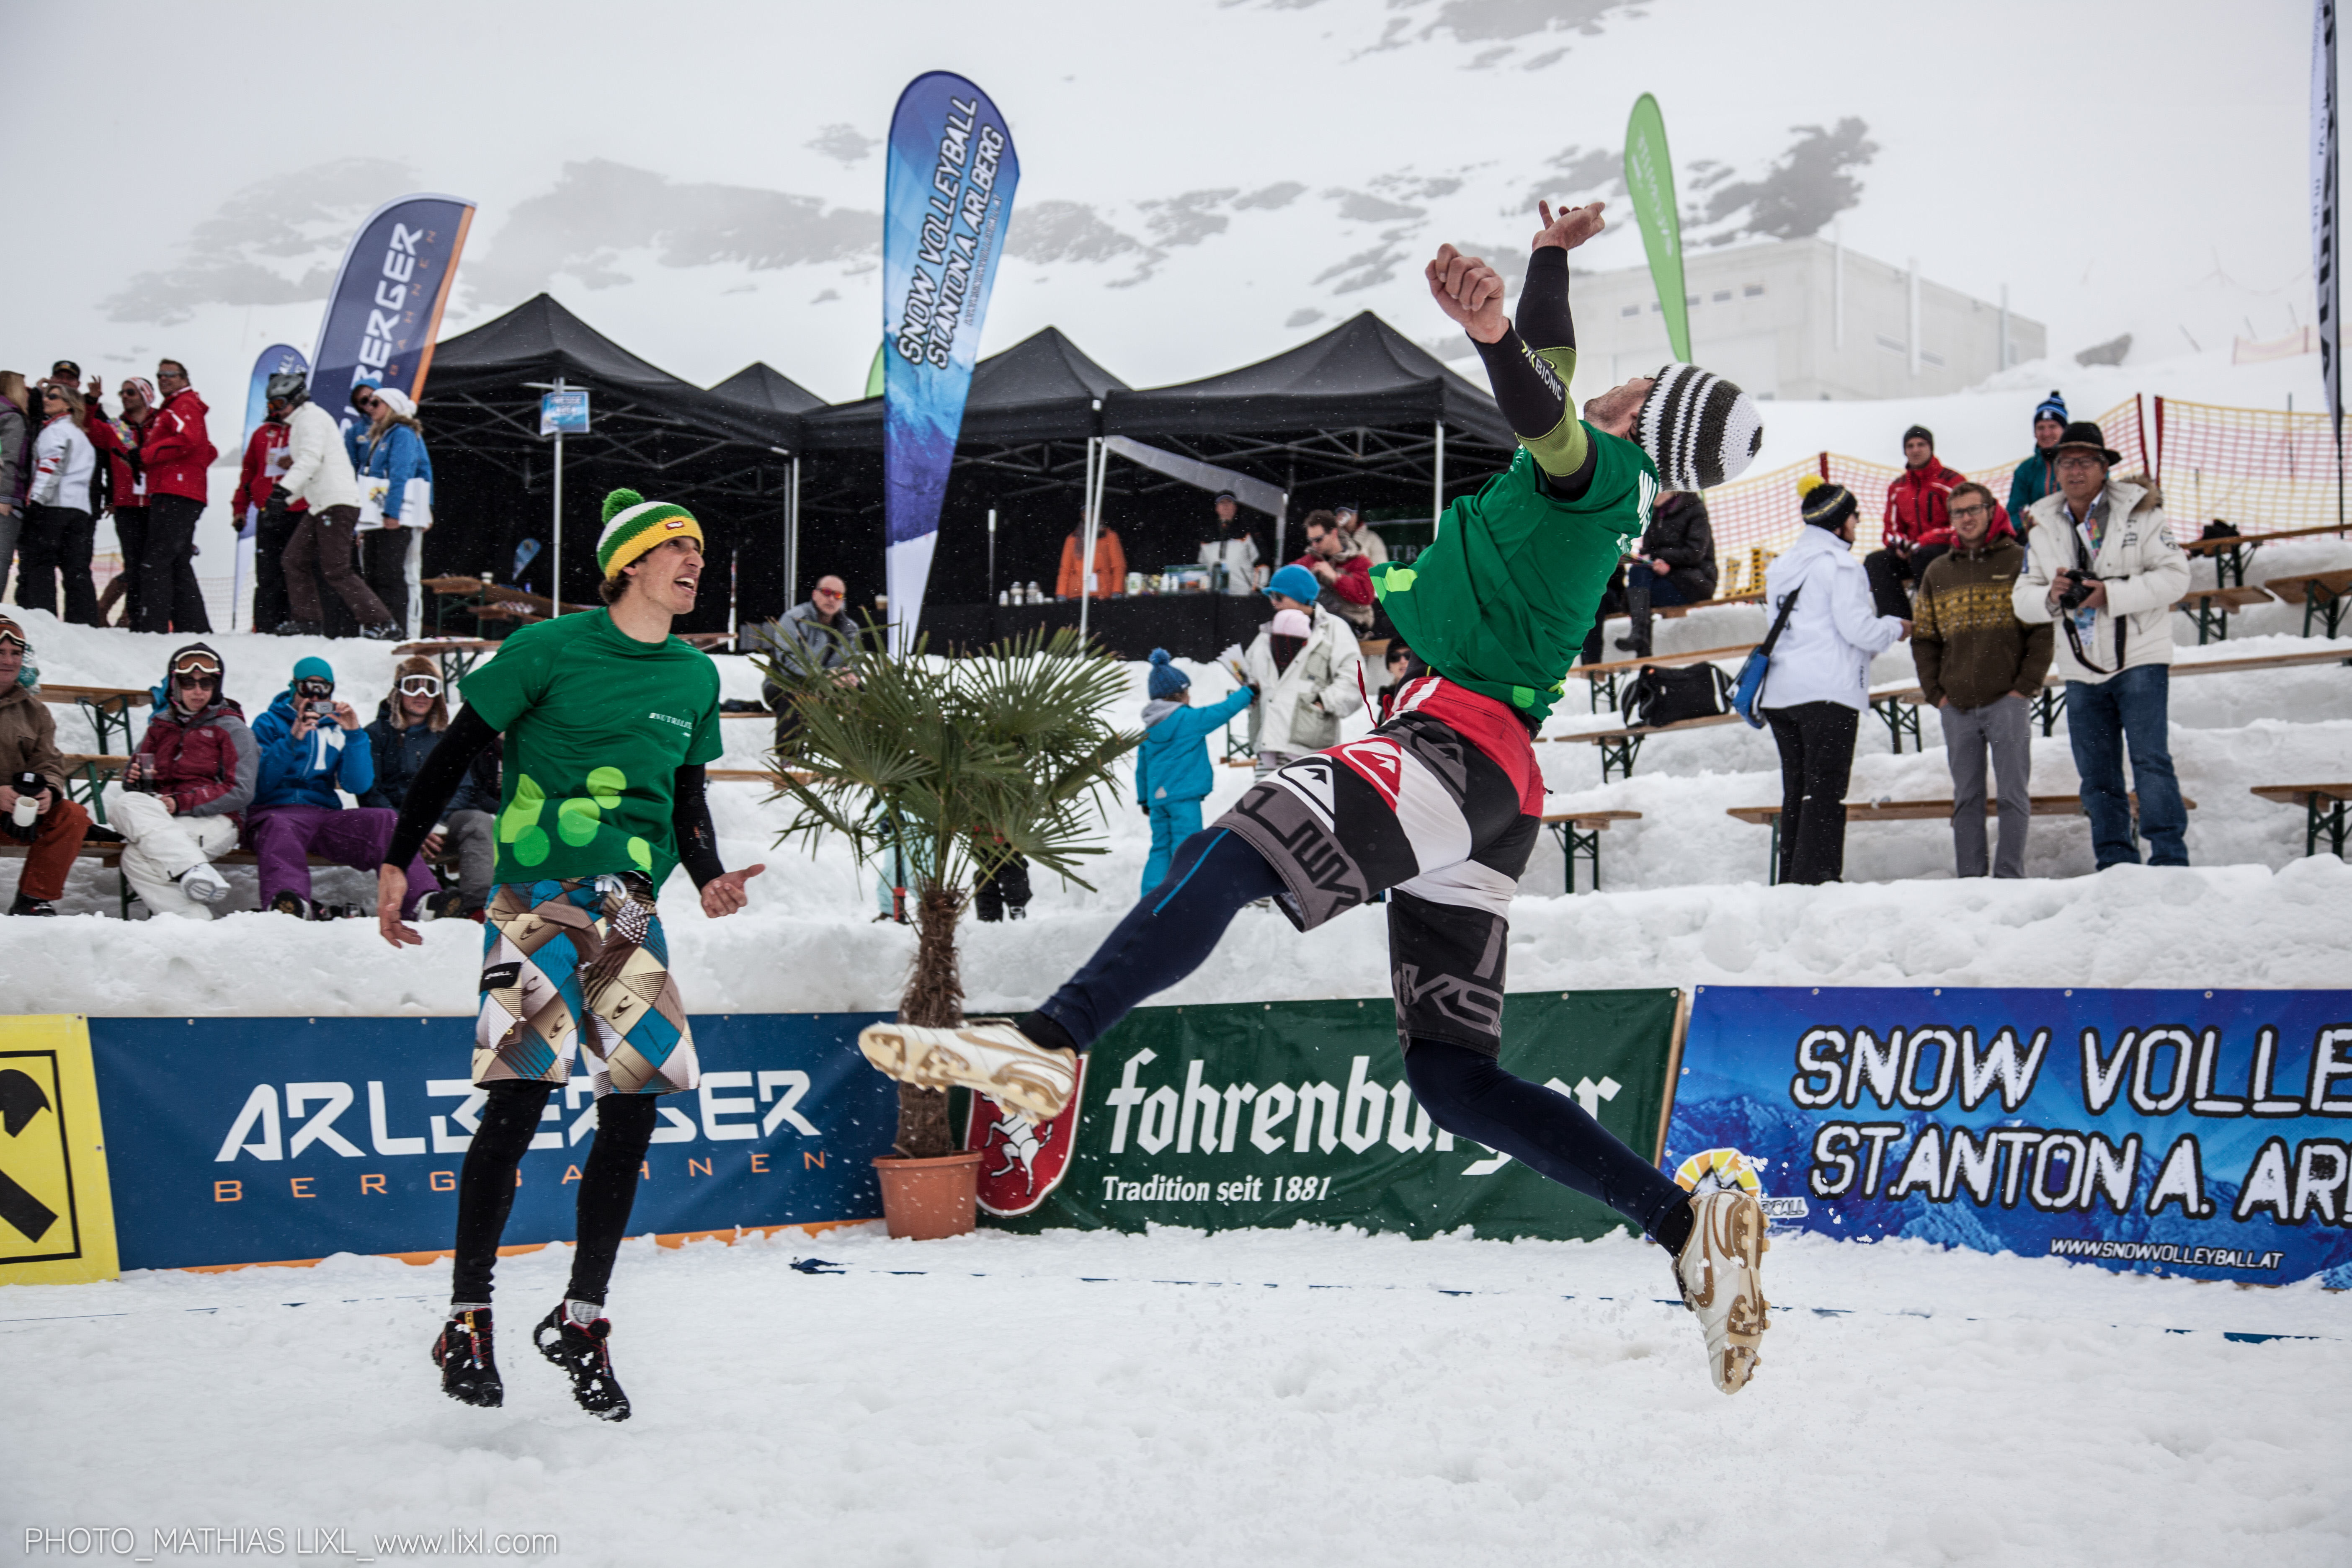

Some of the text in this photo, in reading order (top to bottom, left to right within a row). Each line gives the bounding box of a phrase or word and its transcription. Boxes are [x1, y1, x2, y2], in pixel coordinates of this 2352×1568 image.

[897, 95, 977, 364] SNOW VOLLEYBALL
[961, 123, 1005, 237] ARLBERG
[389, 230, 436, 376] BAHNEN
[1791, 1024, 2352, 1117] SNOW VOLLE
[1103, 1174, 1331, 1202] Tradition seit 1881
[2051, 1238, 2284, 1270] WWW.SNOWVOLLEYBALL.AT
